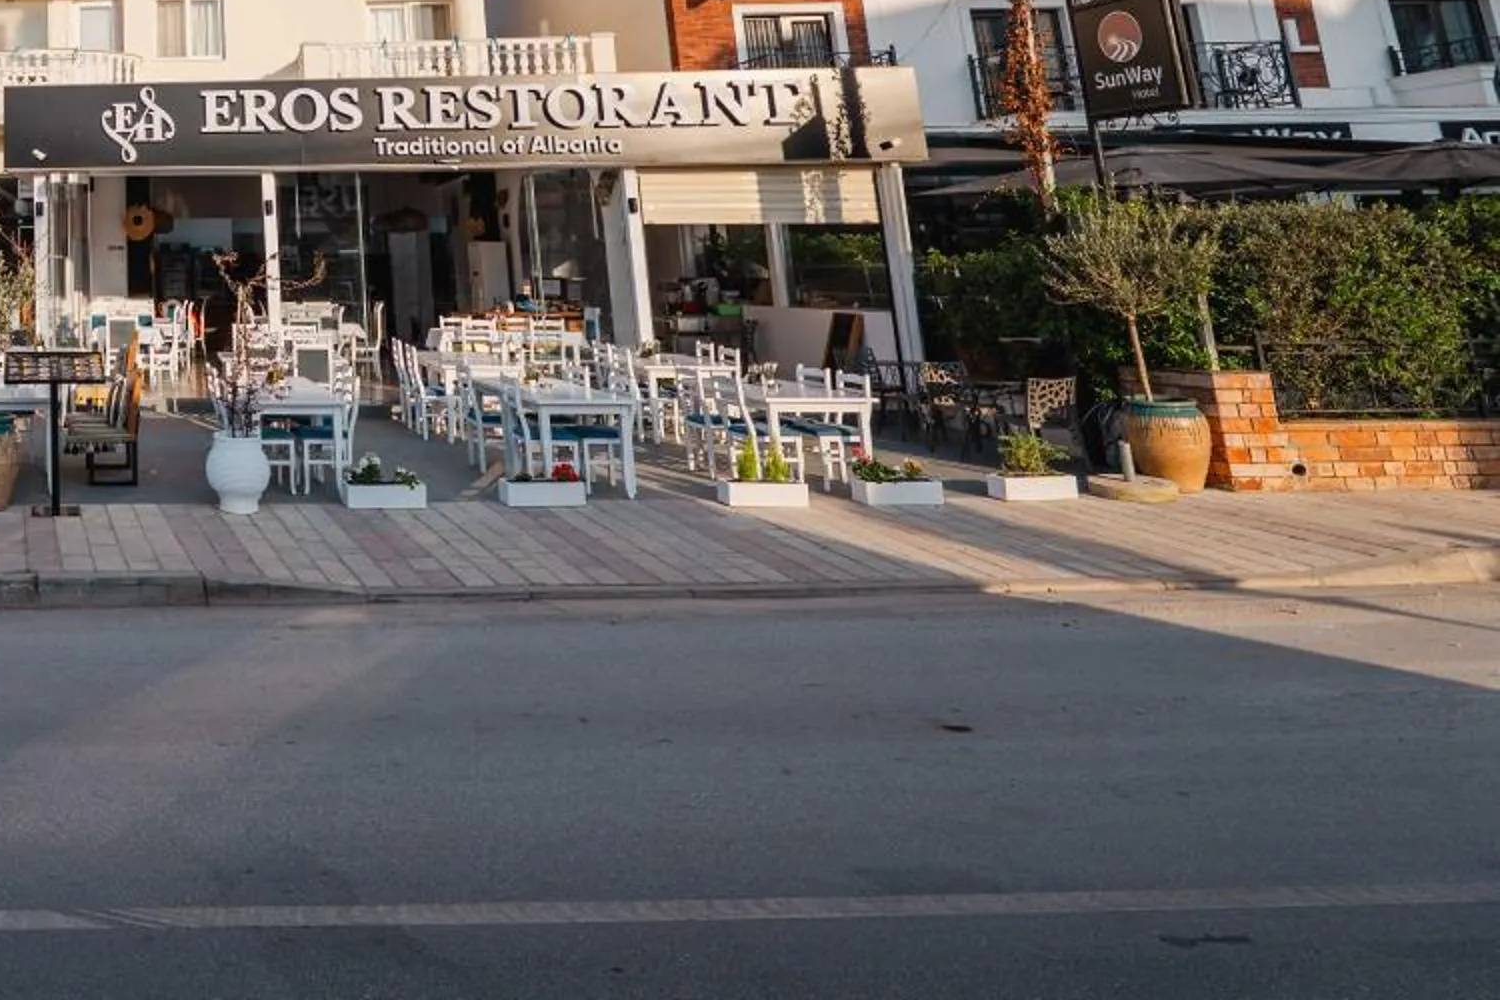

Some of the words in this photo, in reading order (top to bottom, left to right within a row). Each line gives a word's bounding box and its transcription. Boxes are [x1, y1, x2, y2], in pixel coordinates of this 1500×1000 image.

[1094, 65, 1163, 89] SunWay
[200, 87, 364, 134] EROS
[374, 82, 799, 130] RESTORANT
[373, 136, 496, 157] Traditional
[501, 136, 527, 156] of
[530, 134, 623, 155] Albania
